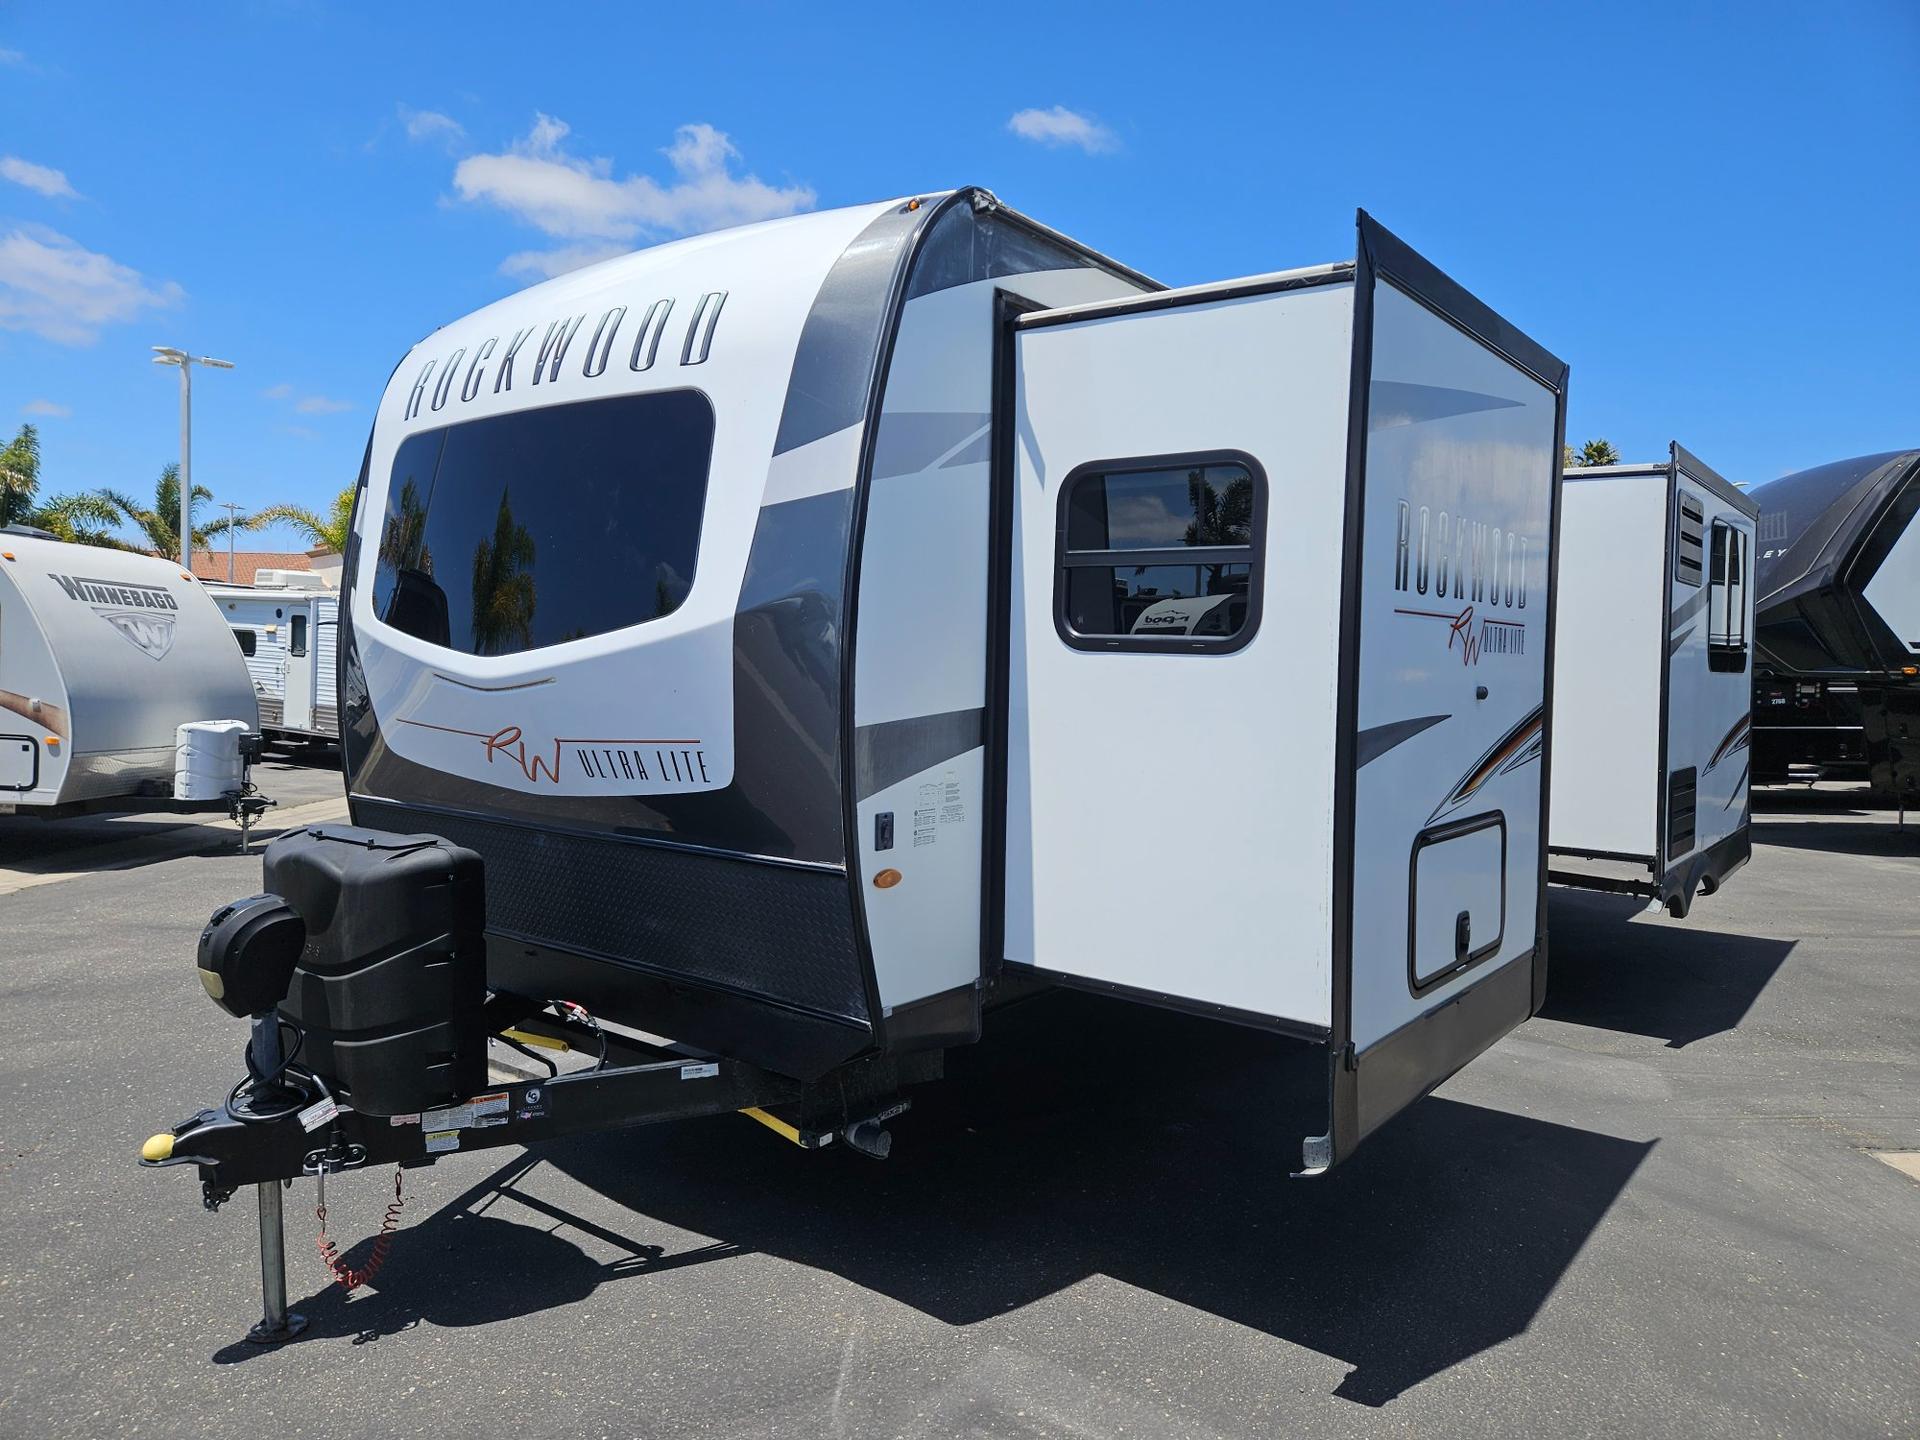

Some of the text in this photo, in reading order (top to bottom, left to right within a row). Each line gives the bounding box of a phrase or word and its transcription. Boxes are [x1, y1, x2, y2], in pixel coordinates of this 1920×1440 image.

[404, 289, 729, 421] ROCKWOOD
[1395, 498, 1528, 609] ROCKWOOD
[1757, 548, 1788, 559] EY
[47, 573, 179, 610] WINNEBAGO
[1484, 626, 1507, 654] ULTRA
[1510, 629, 1526, 655] LITE
[480, 726, 711, 783] RW ULTRA LITE
